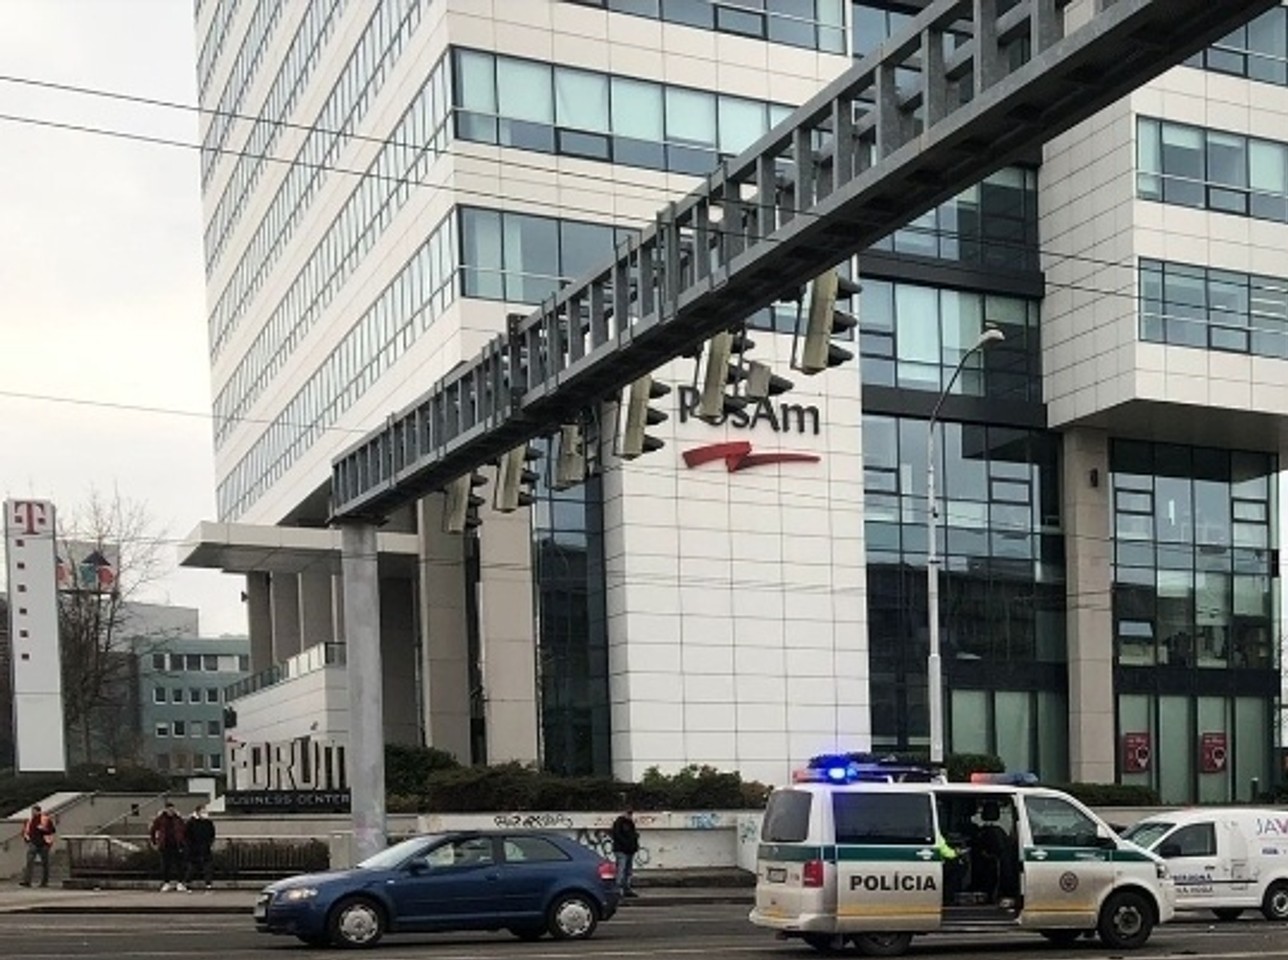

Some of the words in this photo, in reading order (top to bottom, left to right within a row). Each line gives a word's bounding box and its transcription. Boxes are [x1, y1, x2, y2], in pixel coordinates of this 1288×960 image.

[678, 386, 820, 435] PsAm
[226, 740, 351, 790] FORUM
[849, 871, 937, 891] POLÍCIA
